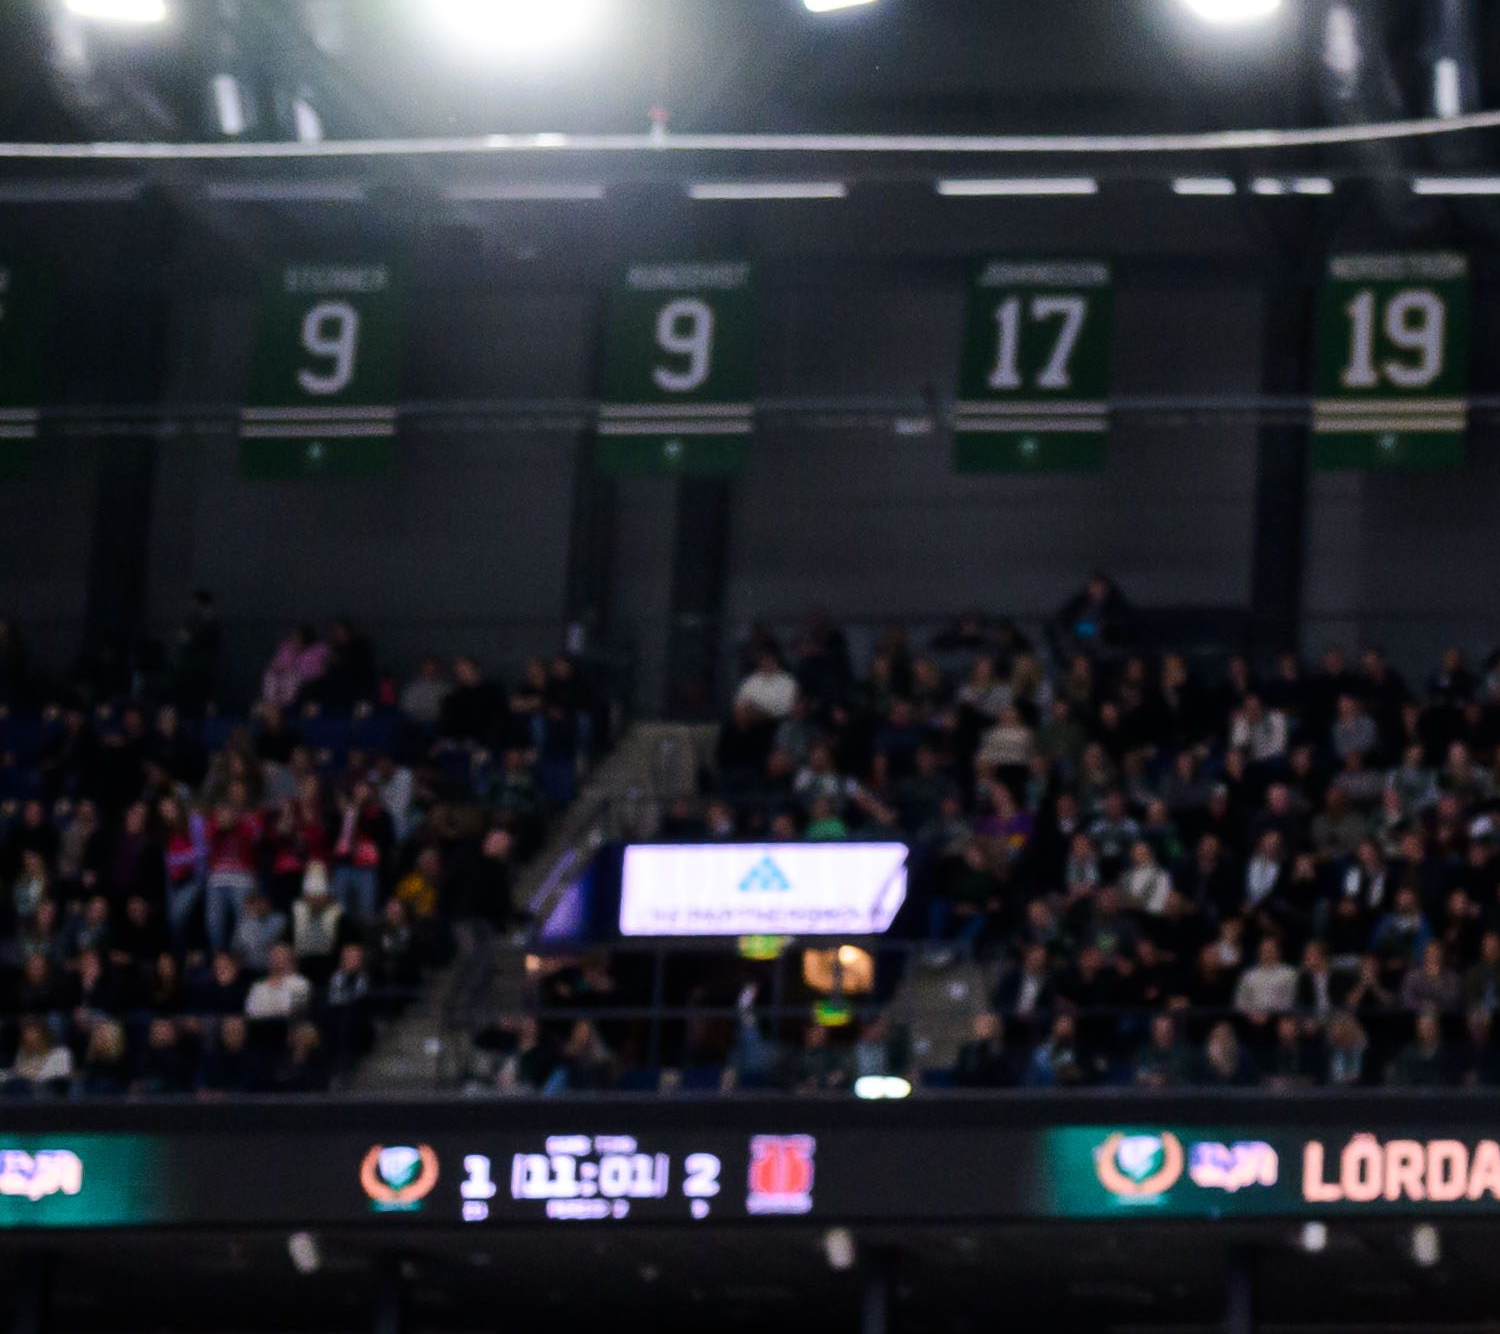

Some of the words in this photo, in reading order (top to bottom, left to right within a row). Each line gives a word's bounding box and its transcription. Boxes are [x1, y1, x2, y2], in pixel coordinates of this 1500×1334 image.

[297, 300, 362, 395] 9
[652, 297, 717, 392] 9
[990, 294, 1088, 390] 17
[1339, 289, 1448, 389] 19
[682, 1153, 722, 1198] 2
